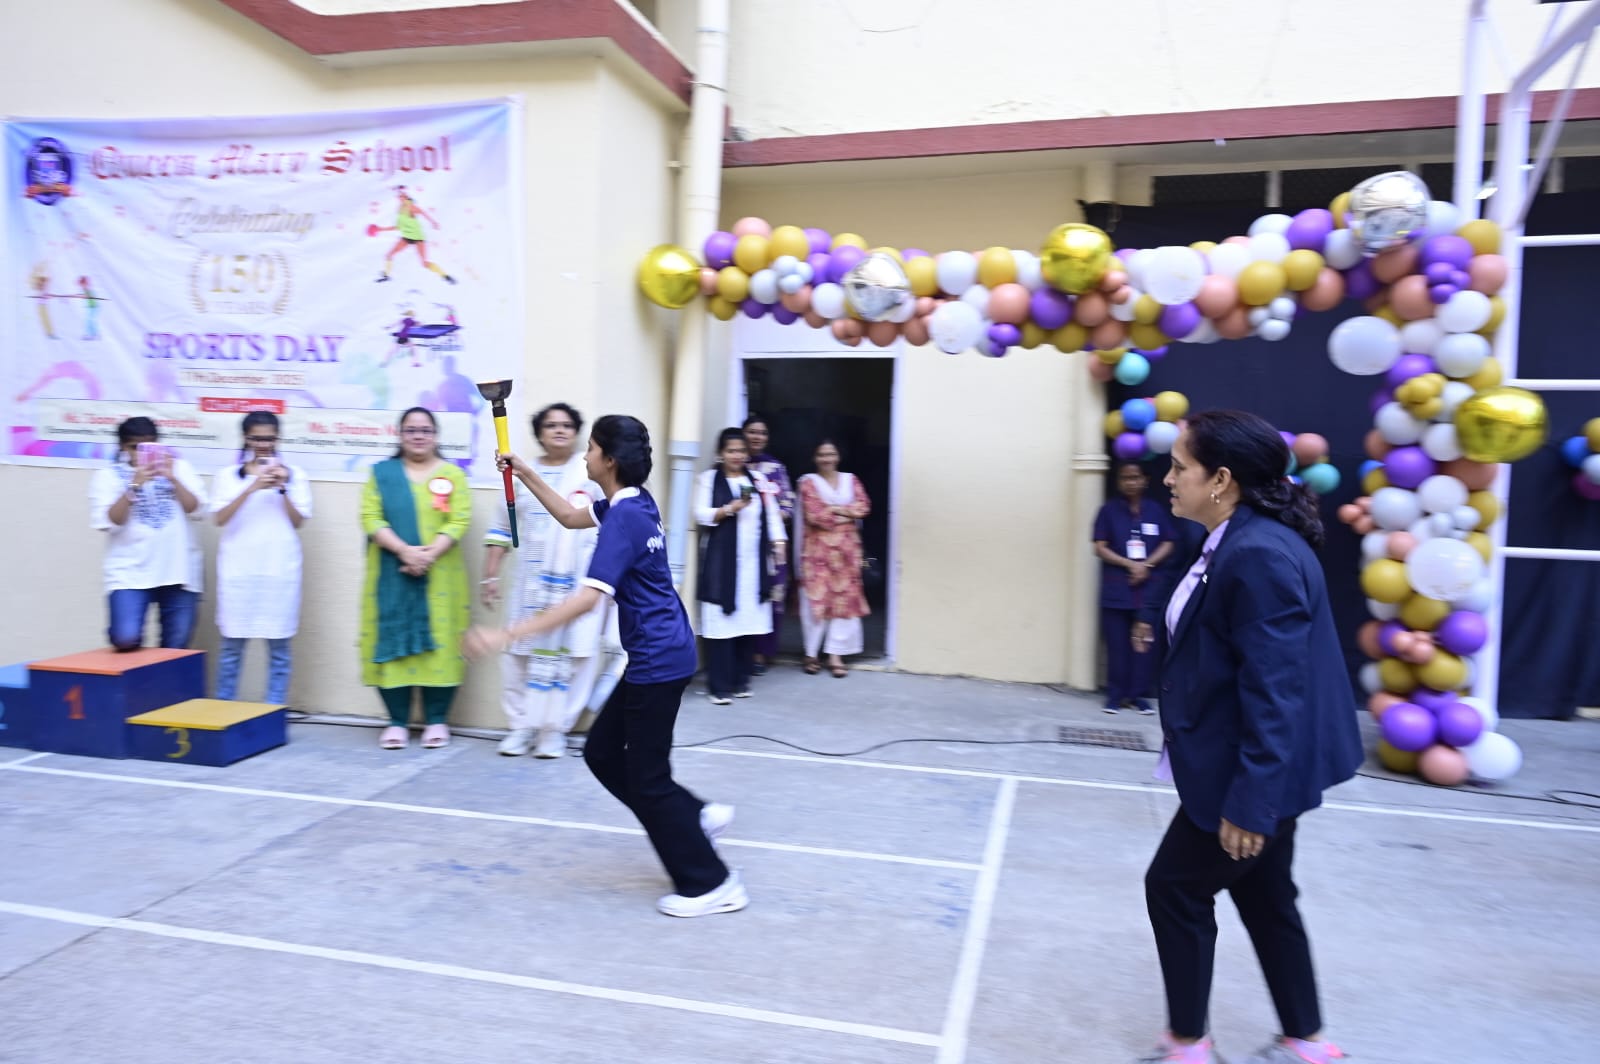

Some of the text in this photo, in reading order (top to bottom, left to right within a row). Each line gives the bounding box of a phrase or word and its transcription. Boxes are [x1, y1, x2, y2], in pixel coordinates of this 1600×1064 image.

[91, 146, 196, 180] Queen
[207, 144, 307, 182] Mary
[320, 136, 451, 179] School
[171, 198, 315, 240] Celebrating
[208, 254, 275, 293] 150
[144, 333, 345, 362] SPORTS DAY
[63, 685, 86, 720] 1
[164, 727, 192, 758] 3
